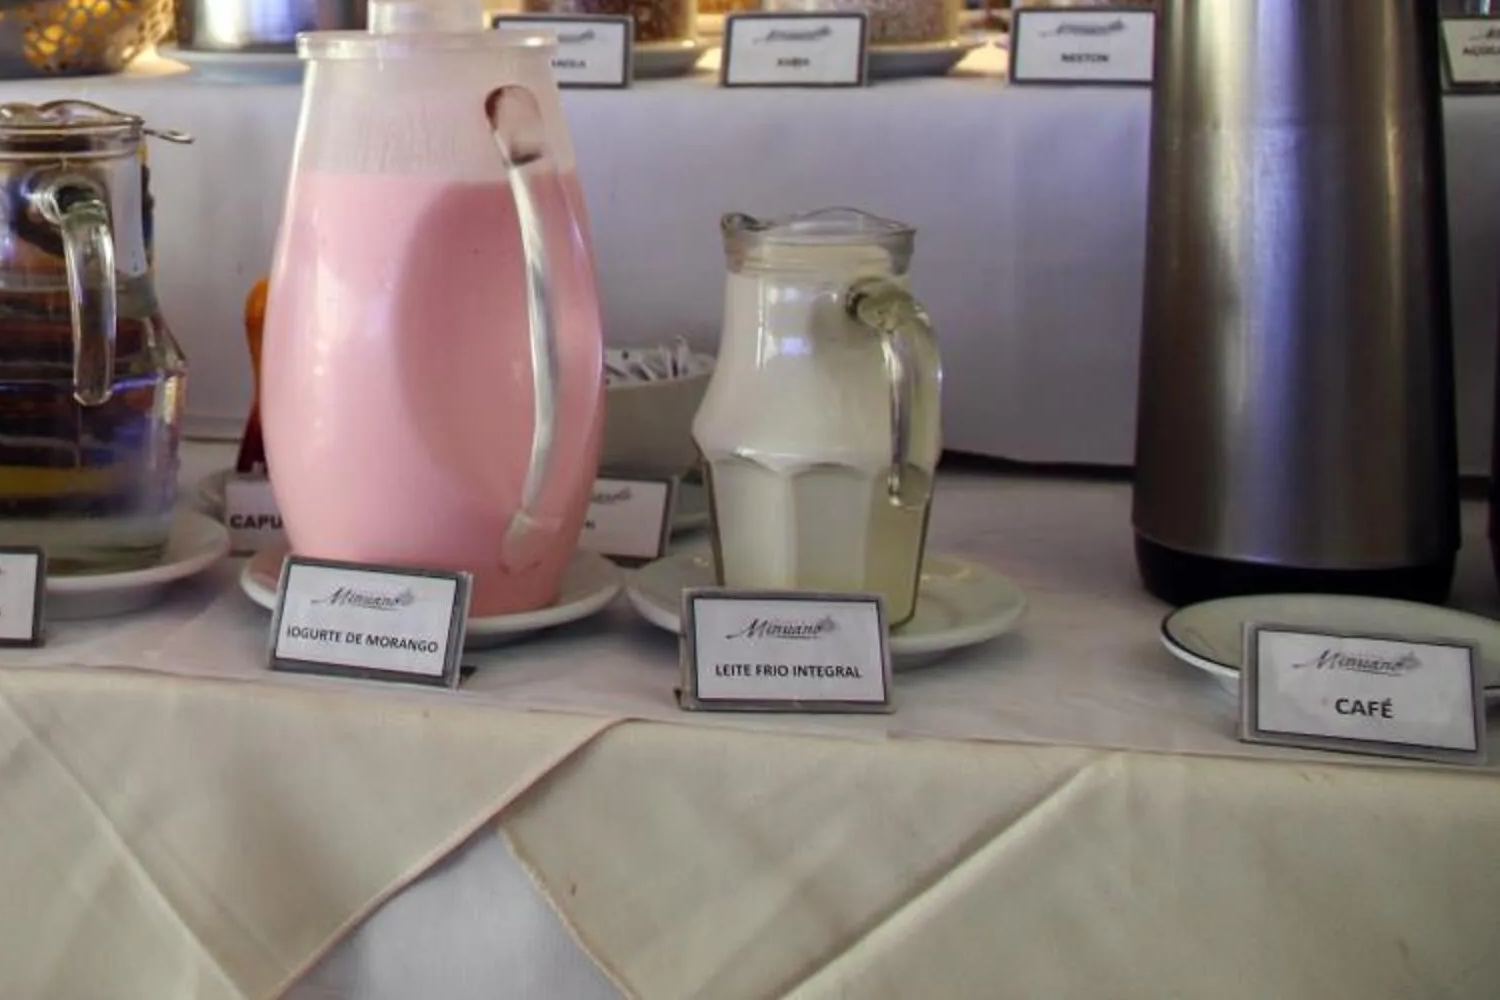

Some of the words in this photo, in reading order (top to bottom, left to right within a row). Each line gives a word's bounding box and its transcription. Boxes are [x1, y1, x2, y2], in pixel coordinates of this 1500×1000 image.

[230, 514, 283, 530] CAPU
[287, 624, 341, 643] IOGURTE
[345, 631, 362, 645] DE
[365, 634, 439, 653] MORANGO
[715, 664, 752, 677] LEITE
[755, 664, 789, 678] FRIO
[793, 665, 862, 679] INTEGRAL
[1334, 698, 1394, 718] CAFÉ
